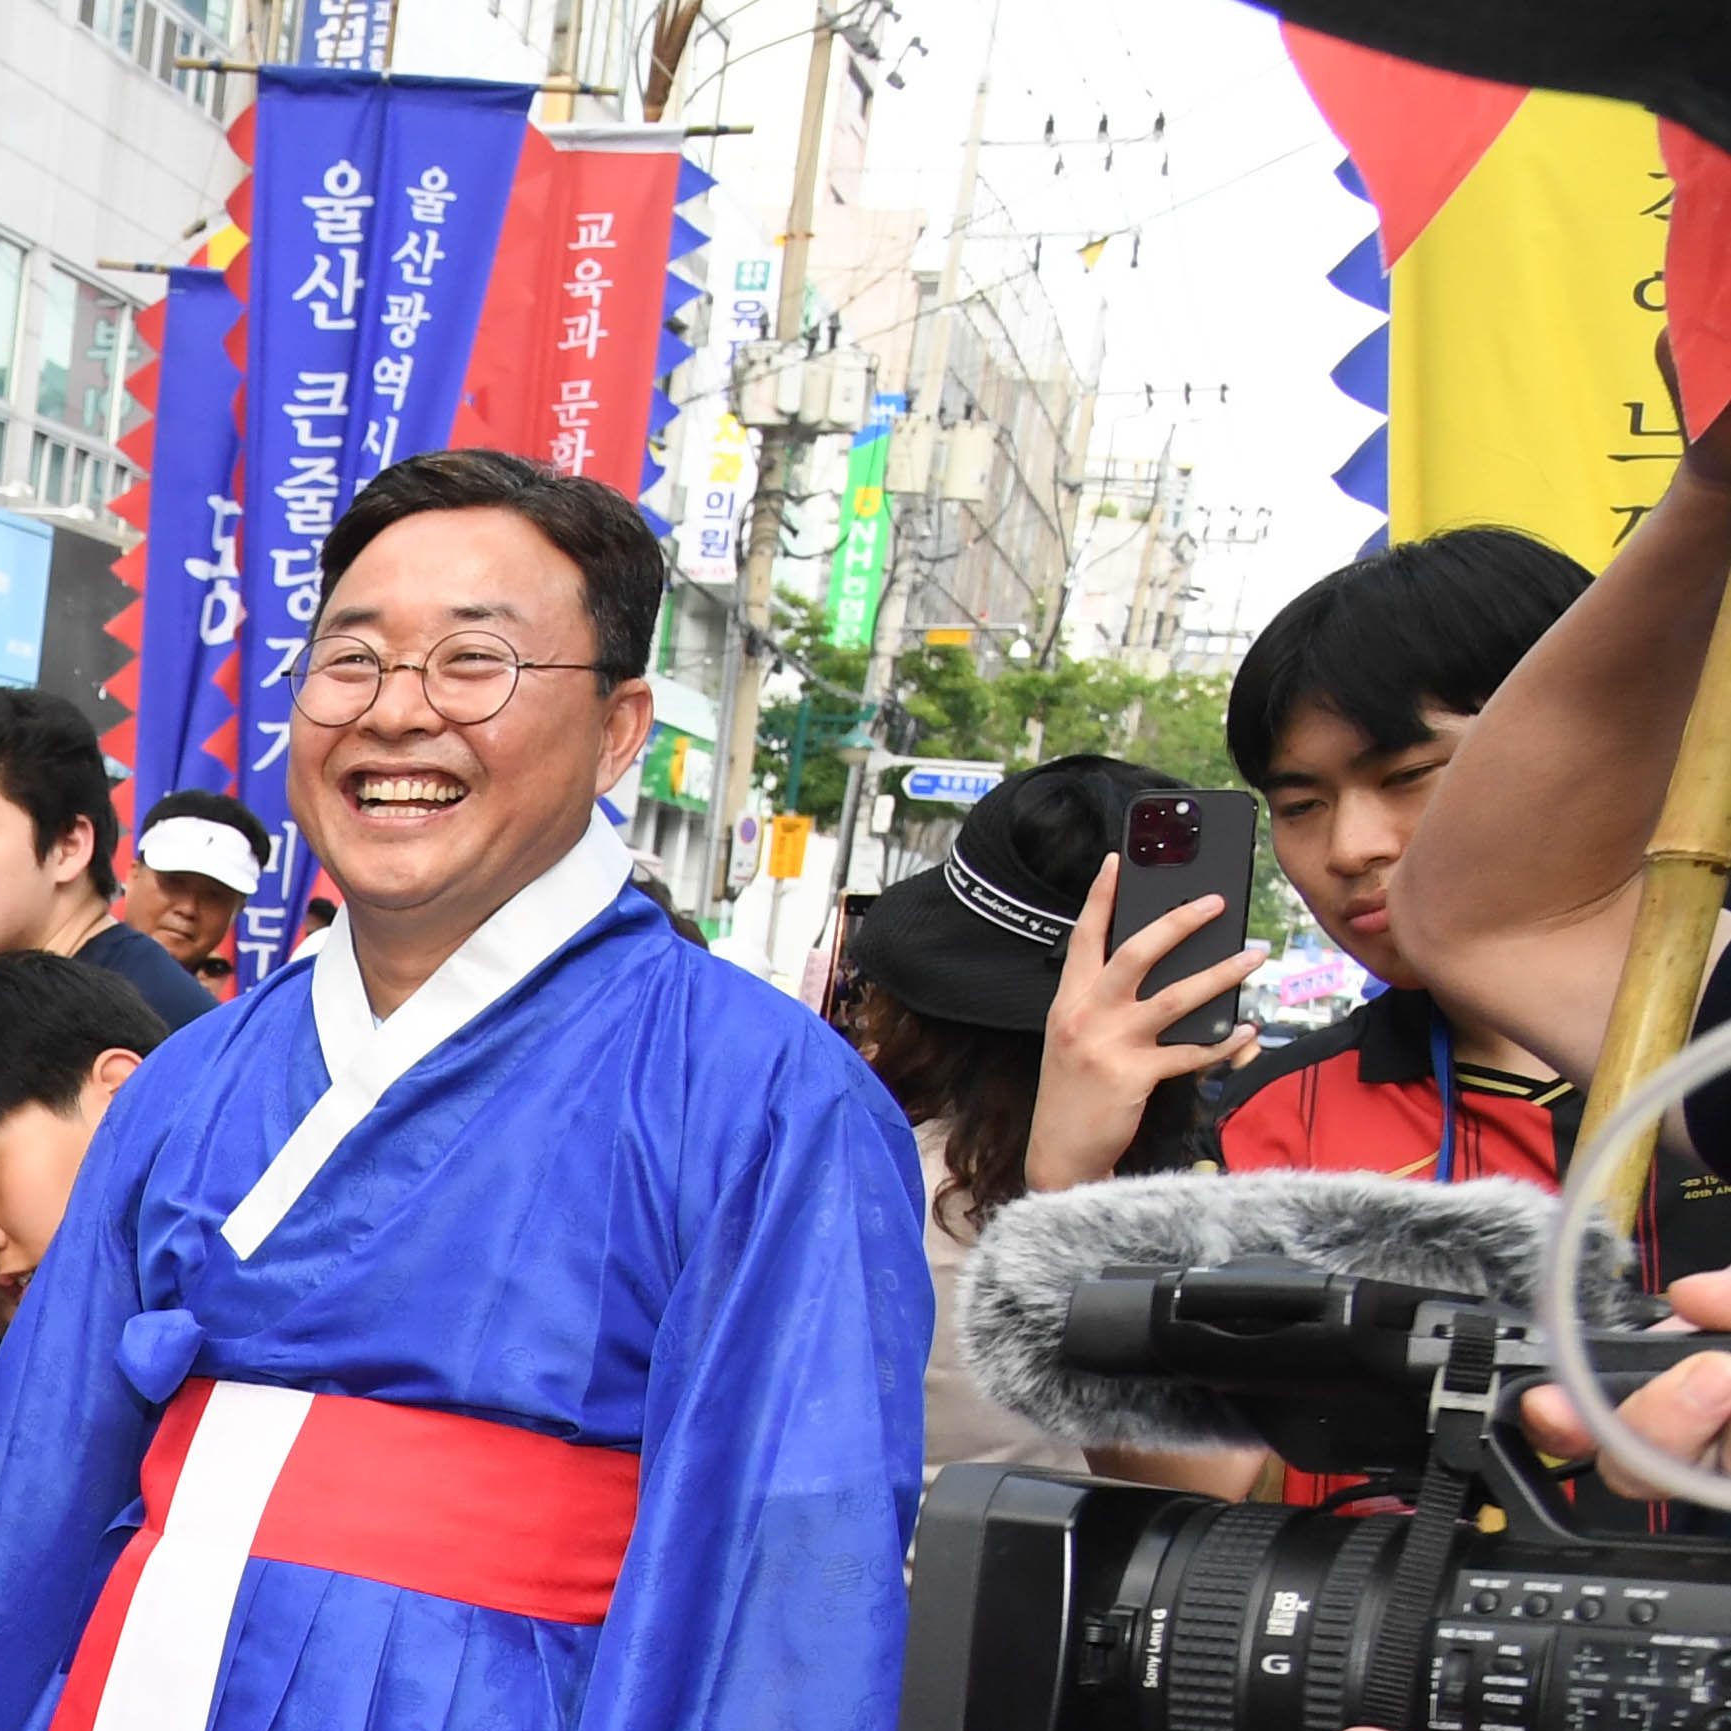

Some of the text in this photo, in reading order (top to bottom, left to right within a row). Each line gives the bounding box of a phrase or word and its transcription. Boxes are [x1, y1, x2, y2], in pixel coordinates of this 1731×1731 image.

[292, 160, 375, 330] 울산
[557, 213, 617, 360] 교육과
[355, 166, 457, 496] 울산광역시
[1143, 1656, 1163, 1689] Sony
[1146, 1622, 1165, 1655] Lens
[1260, 1654, 1291, 1675] G
